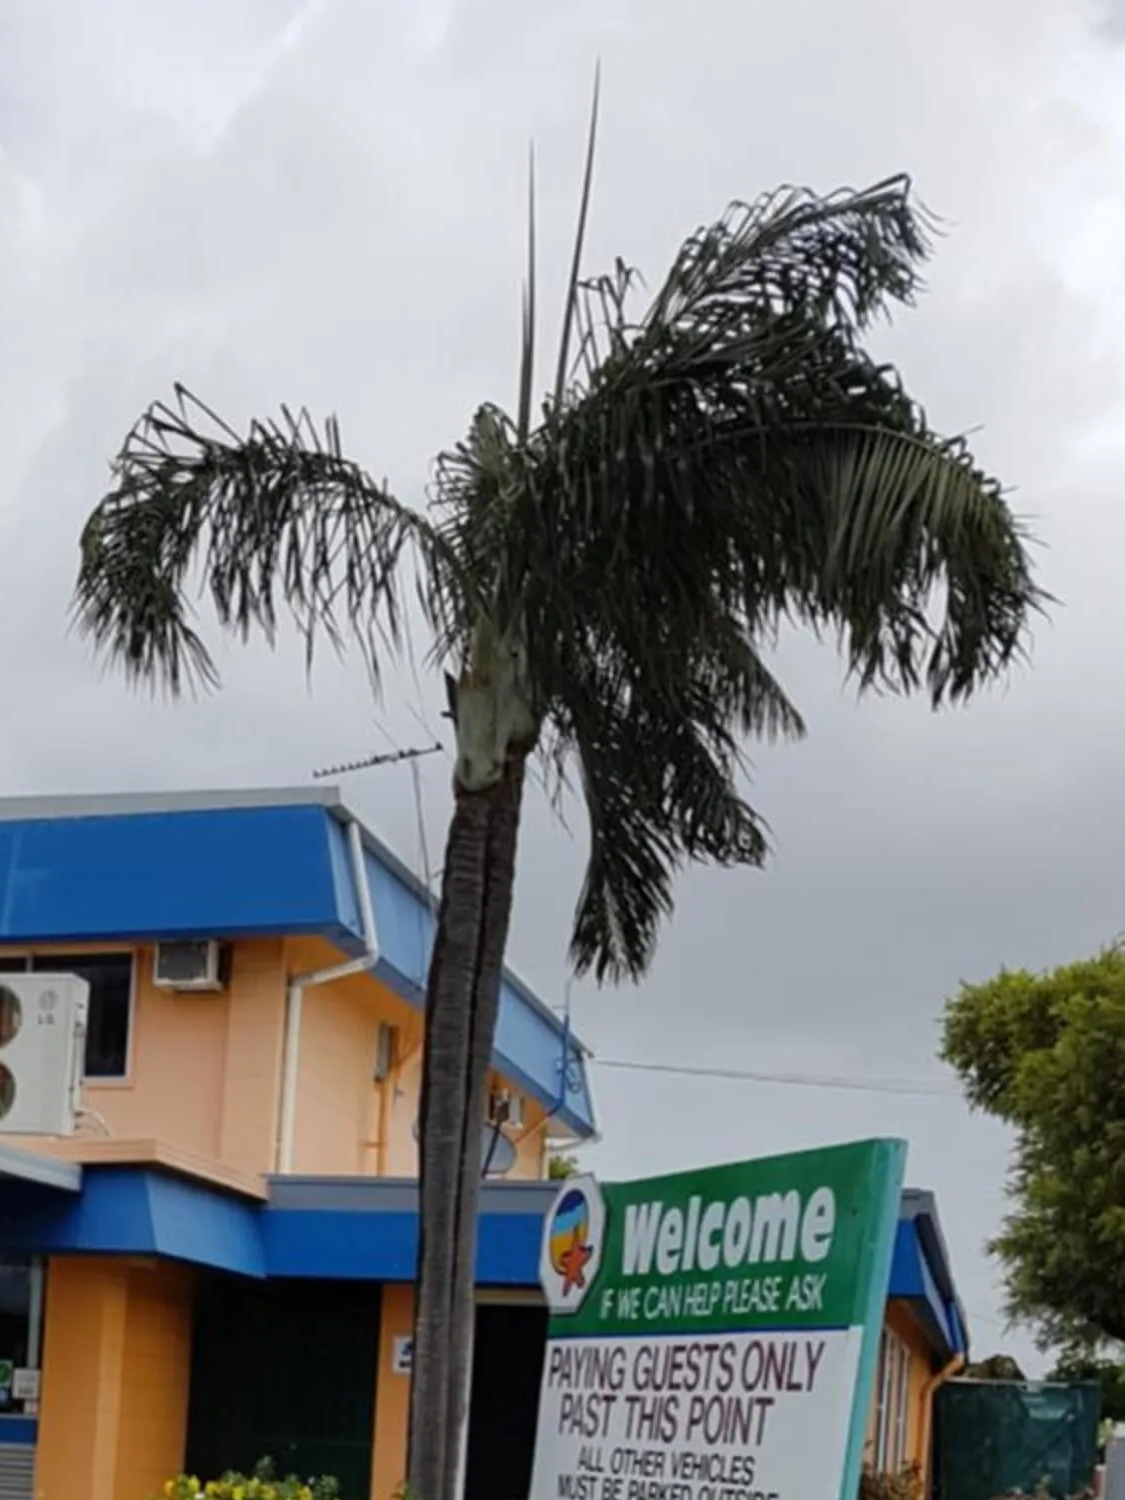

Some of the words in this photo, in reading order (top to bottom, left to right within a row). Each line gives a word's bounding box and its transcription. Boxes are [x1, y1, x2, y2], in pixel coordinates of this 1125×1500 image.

[622, 1186, 836, 1276] Welcome
[599, 1289, 615, 1320] IF
[617, 1287, 641, 1320] WE
[643, 1285, 682, 1320] CAN
[683, 1280, 722, 1316] HELP
[722, 1276, 782, 1314] PLEASE
[784, 1273, 827, 1311] ASK
[548, 1346, 626, 1391] PAYING
[632, 1342, 737, 1392] GUESTS
[741, 1340, 825, 1392] ONLY
[558, 1393, 618, 1438] PAST
[624, 1395, 679, 1443] THIS
[686, 1397, 775, 1446] POINT
[558, 1473, 597, 1500] MUST
[578, 1446, 605, 1472] ALL
[610, 1447, 665, 1477] OTHER
[671, 1452, 755, 1486] VEHICLES
